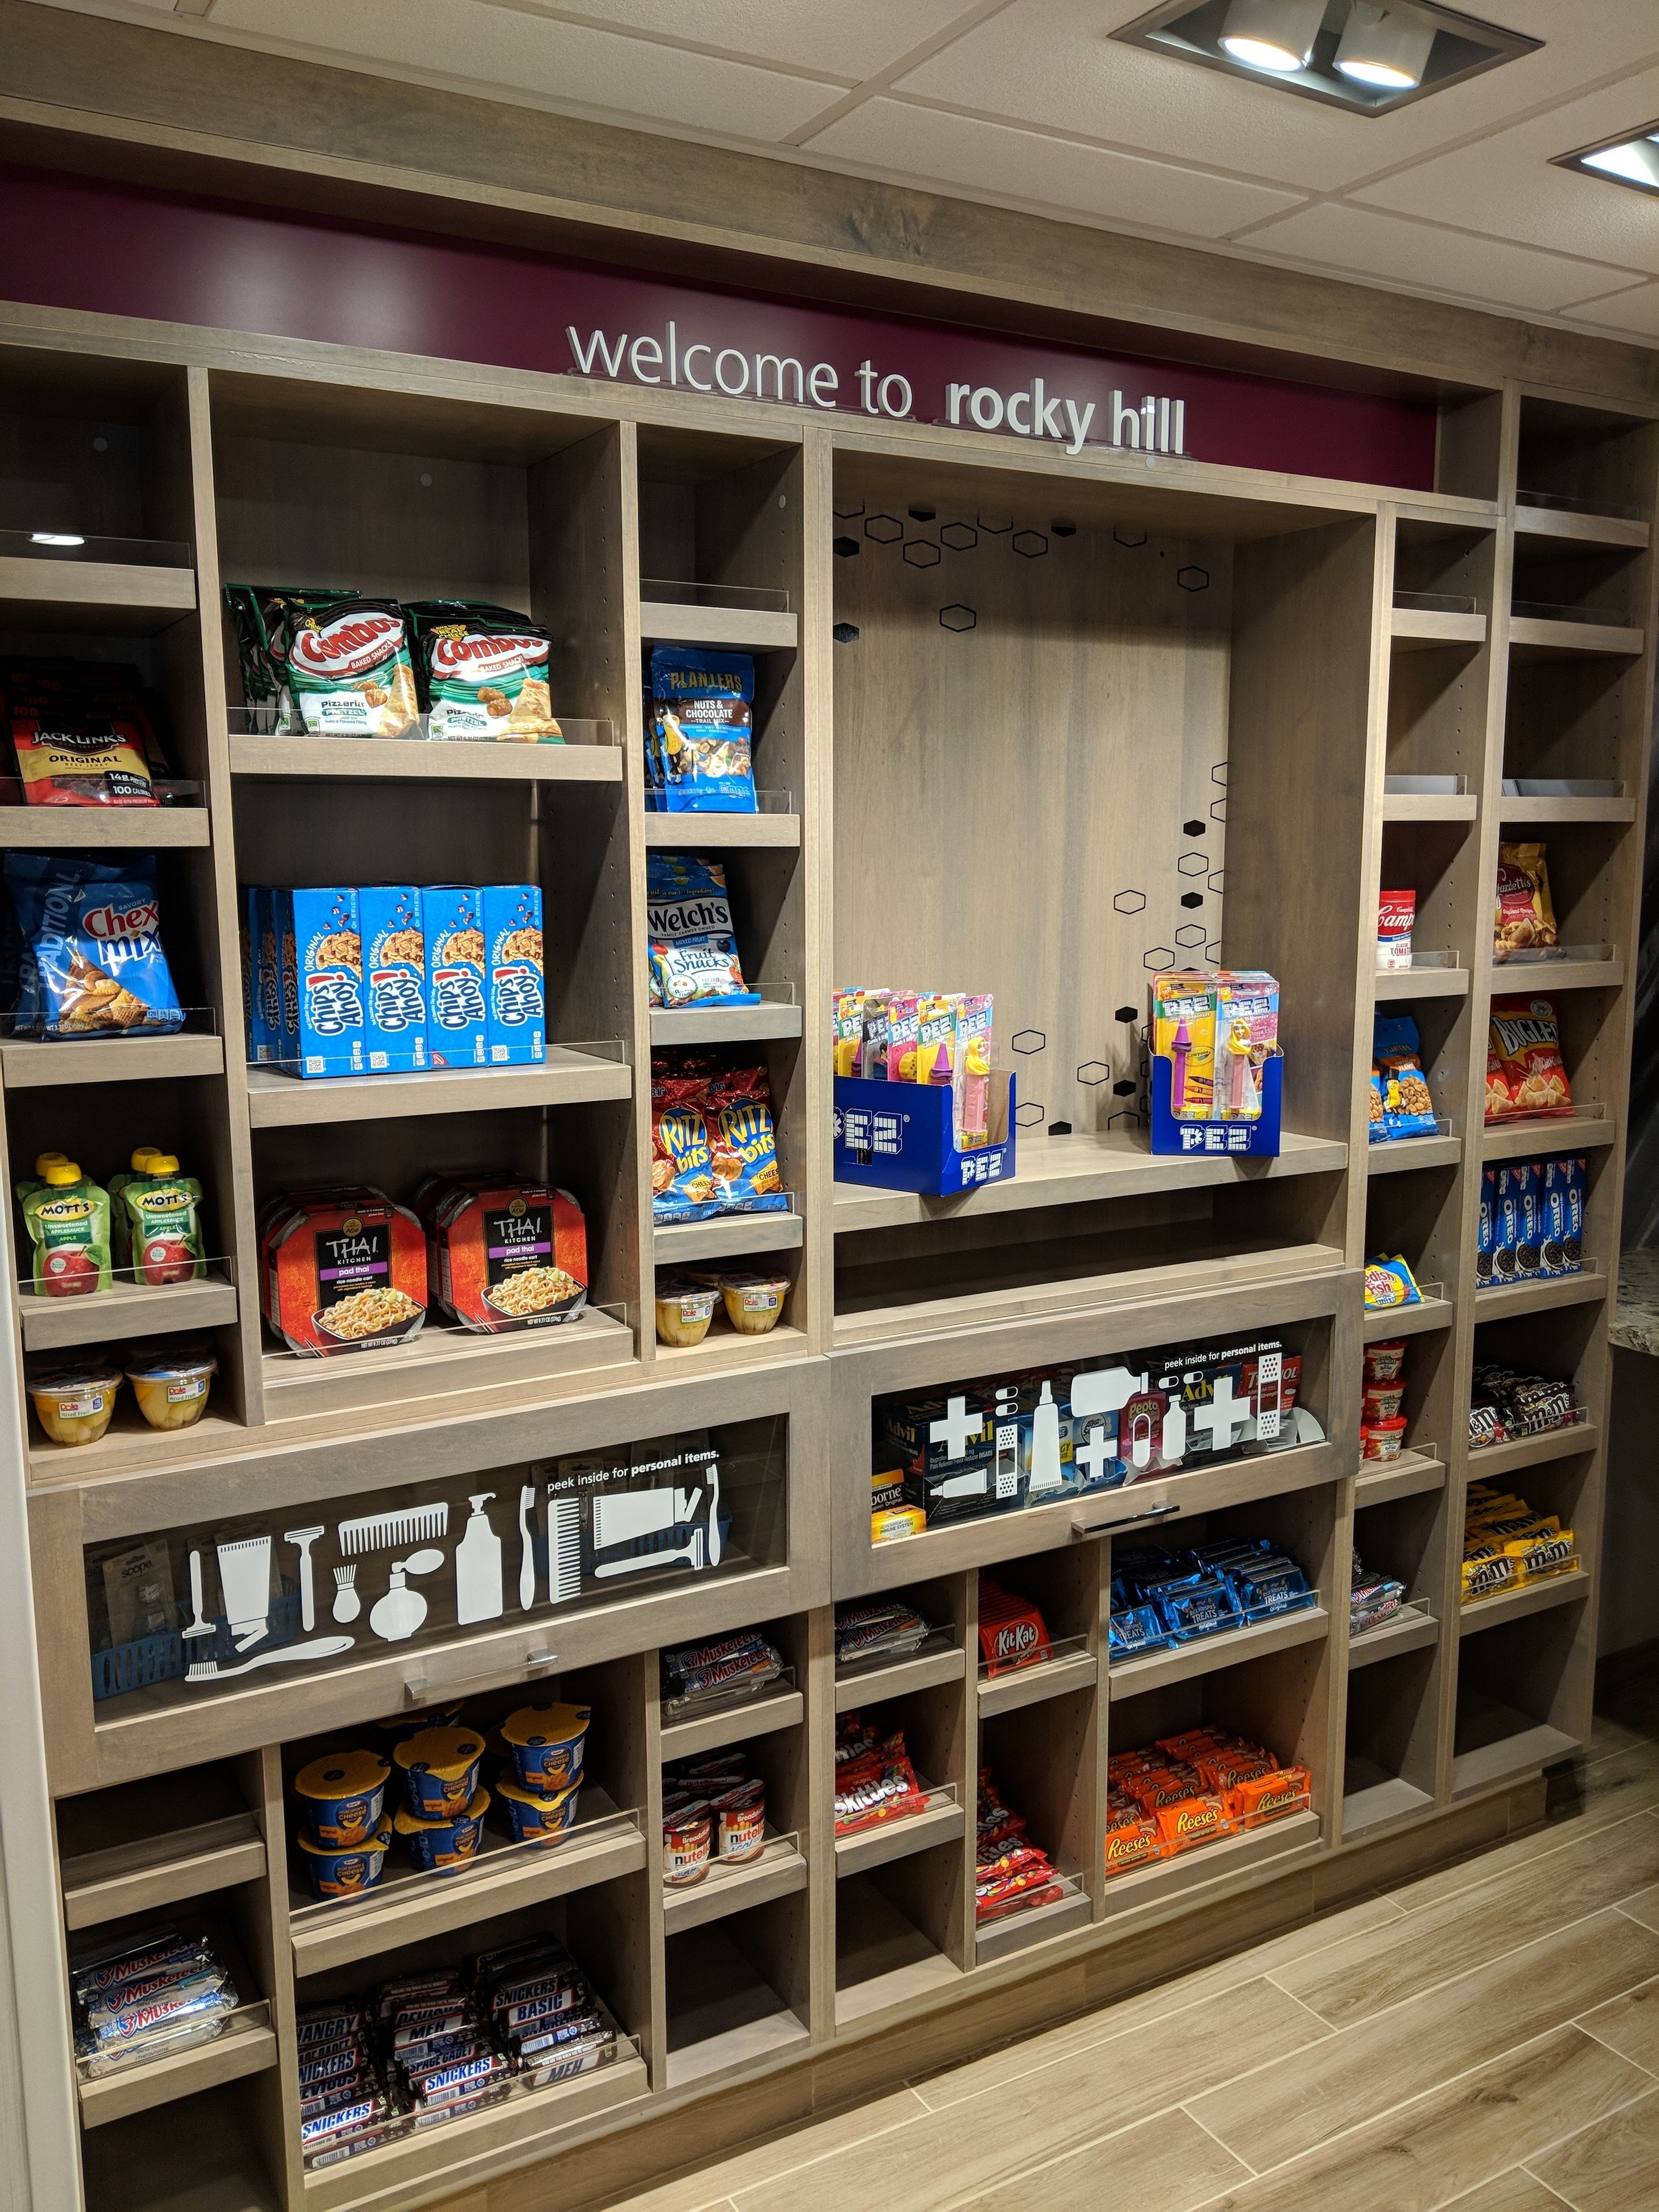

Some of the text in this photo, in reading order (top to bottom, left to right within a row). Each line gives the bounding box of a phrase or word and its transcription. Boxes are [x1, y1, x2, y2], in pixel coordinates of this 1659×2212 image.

[566, 320, 1184, 455] welcome to rocky hill
[351, 641, 393, 669] BAKED SNACKS
[479, 663, 502, 673] BAKED
[670, 672, 743, 692] PLANTERS
[685, 709, 733, 719] CHOCOLATE
[694, 700, 724, 709] NUTS &
[32, 732, 75, 744] JACK
[49, 755, 122, 764] ORIGINAL
[113, 786, 132, 795] 100
[118, 897, 146, 911] SAVORY
[84, 902, 160, 938] Chex
[647, 902, 729, 933] Welch's
[101, 930, 161, 962] mix
[304, 931, 325, 972] ORIGINAL
[368, 930, 389, 969] ORIGINAL
[431, 930, 451, 968] ORIGINAL
[491, 928, 510, 966] ORIGINAL
[675, 938, 692, 946] MIXED
[674, 957, 730, 973] Snacks
[679, 949, 716, 962] Fruit
[1163, 995, 1211, 1017] PEZ
[1187, 1012, 1210, 1020] Dispenser
[1222, 995, 1271, 1018] PEZ
[921, 1014, 952, 1043] PEZ
[958, 1010, 987, 1039] PEZ
[1491, 1016, 1558, 1056] BUGLES
[707, 1082, 726, 1093] BAG
[660, 1114, 705, 1155] RITZ
[720, 1104, 771, 1149] RITZ
[1180, 1124, 1252, 1151] PEZ
[676, 1145, 709, 1174] bits
[738, 1132, 777, 1164] bits
[961, 1151, 1004, 1185] PEZ
[40, 1203, 90, 1217] MOTT'S
[141, 1193, 188, 1207] MOTT'S
[1569, 1188, 1579, 1233] OREO
[44, 1220, 88, 1229] Unsweetened
[145, 1210, 187, 1219] Unsweetened
[1480, 1202, 1489, 1247] OREO
[1503, 1199, 1513, 1245] OREO
[1523, 1194, 1533, 1240] OREO
[1550, 1192, 1560, 1237] OREO
[50, 1226, 85, 1234] APPLESAUCE
[493, 1217, 543, 1238] THAI
[325, 1236, 379, 1260] THAI
[505, 1236, 536, 1244] KITCHEN
[506, 1247, 520, 1256] pad
[337, 1256, 372, 1266] KITCHEN
[339, 1265, 370, 1277] pad thai
[1164, 1340, 1282, 1371] peek inside for personal items.
[168, 1387, 187, 1395] Dole
[60, 1403, 78, 1411] Dole
[1128, 1399, 1159, 1421] Pepto
[1085, 1418, 1102, 1429] Alka-
[930, 1455, 946, 1463] Ibuprofen
[964, 1455, 979, 1463] Reducer
[979, 1449, 993, 1460] (NSAID)
[547, 1450, 720, 1494] peek inside for personal items.
[885, 1497, 903, 1506] Original
[880, 1521, 914, 1534] IMMUNE SYSTEM
[890, 1519, 904, 1527] SUPPORT
[1522, 1538, 1573, 1576] m&m's
[121, 1559, 153, 1579] scope
[1264, 1591, 1289, 1604] TREATS
[1192, 1609, 1218, 1623] TREATS
[1199, 1620, 1218, 1631] original
[696, 1634, 760, 1668] Musketeers
[998, 1624, 1035, 1657] Kit Kat
[698, 1649, 770, 1690] 3 Musketeers
[1228, 1766, 1266, 1790] Reese's
[835, 1775, 908, 1819] Skittles
[1156, 1785, 1195, 1808] Reese's
[1257, 1788, 1297, 1812] Reese's
[1176, 1808, 1218, 1834] Reese's
[1107, 1834, 1152, 1861] Reese's
[97, 1966, 114, 1988] 3
[108, 1991, 126, 2012] 3
[495, 1979, 557, 2008] SNICKERS
[517, 1994, 564, 2021] BASIC
[119, 2013, 135, 2036] 3
[409, 2020, 446, 2041] MEH
[408, 2044, 472, 2074] SPACE CADET
[427, 2058, 491, 2093] SNICKERS
[302, 2103, 372, 2140] SNICKERS
